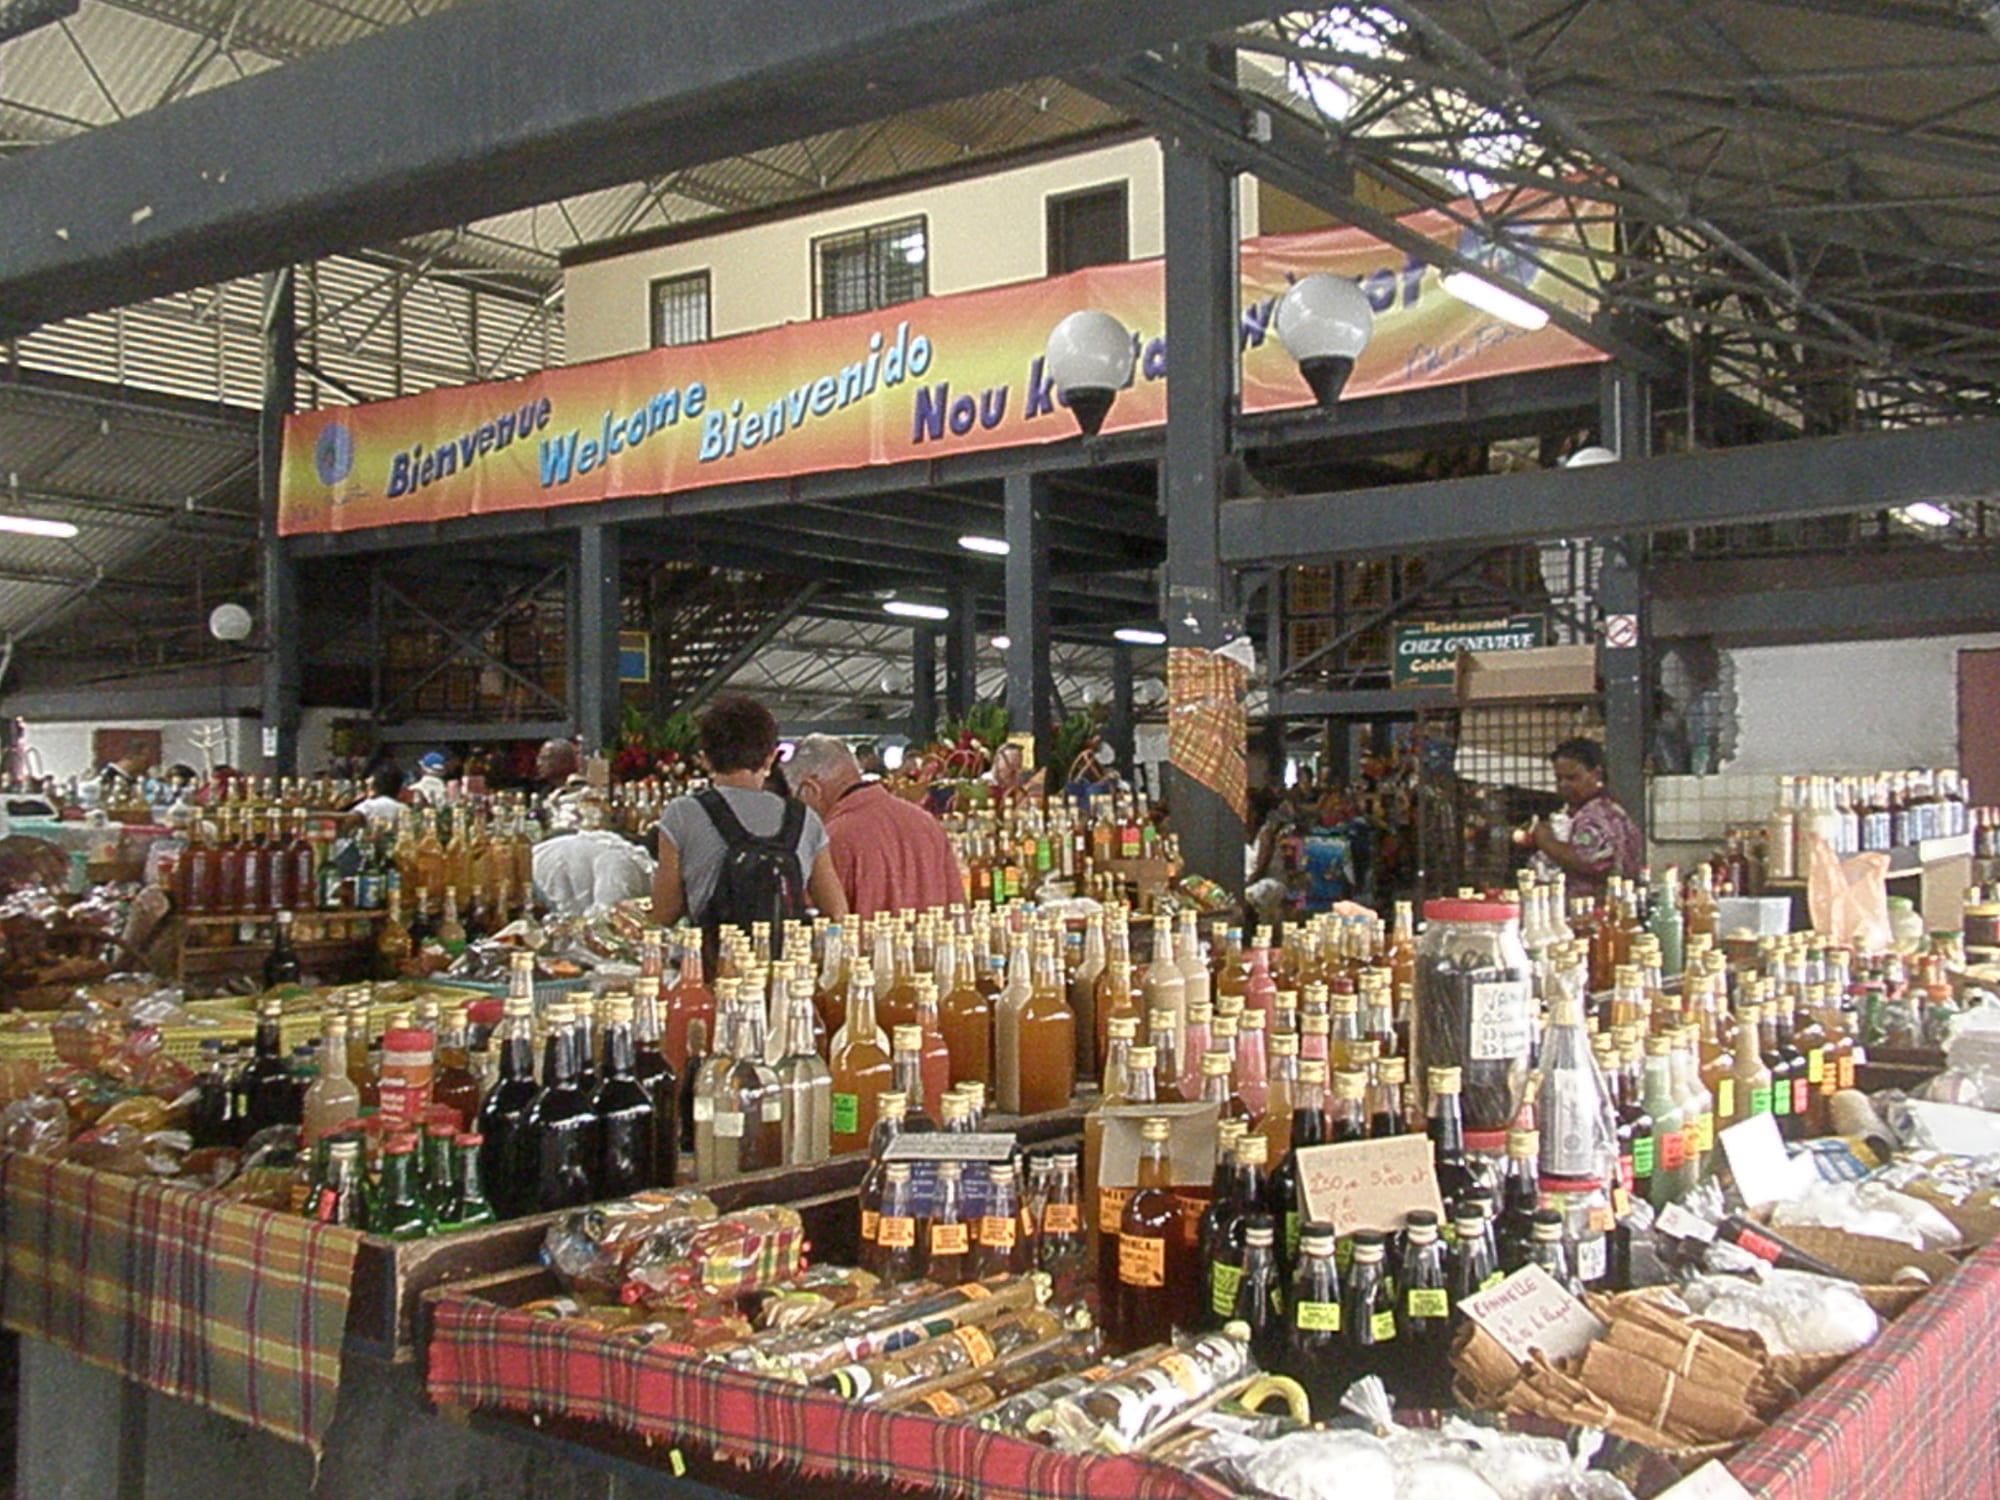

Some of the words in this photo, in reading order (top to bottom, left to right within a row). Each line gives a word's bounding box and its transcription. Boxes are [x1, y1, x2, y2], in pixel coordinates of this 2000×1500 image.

[540, 381, 706, 488] Welcome
[700, 321, 932, 463] Bienvenido
[912, 382, 1008, 443] Nou
[387, 397, 552, 498] Bienvenue
[1399, 637, 1442, 655] CHEZ
